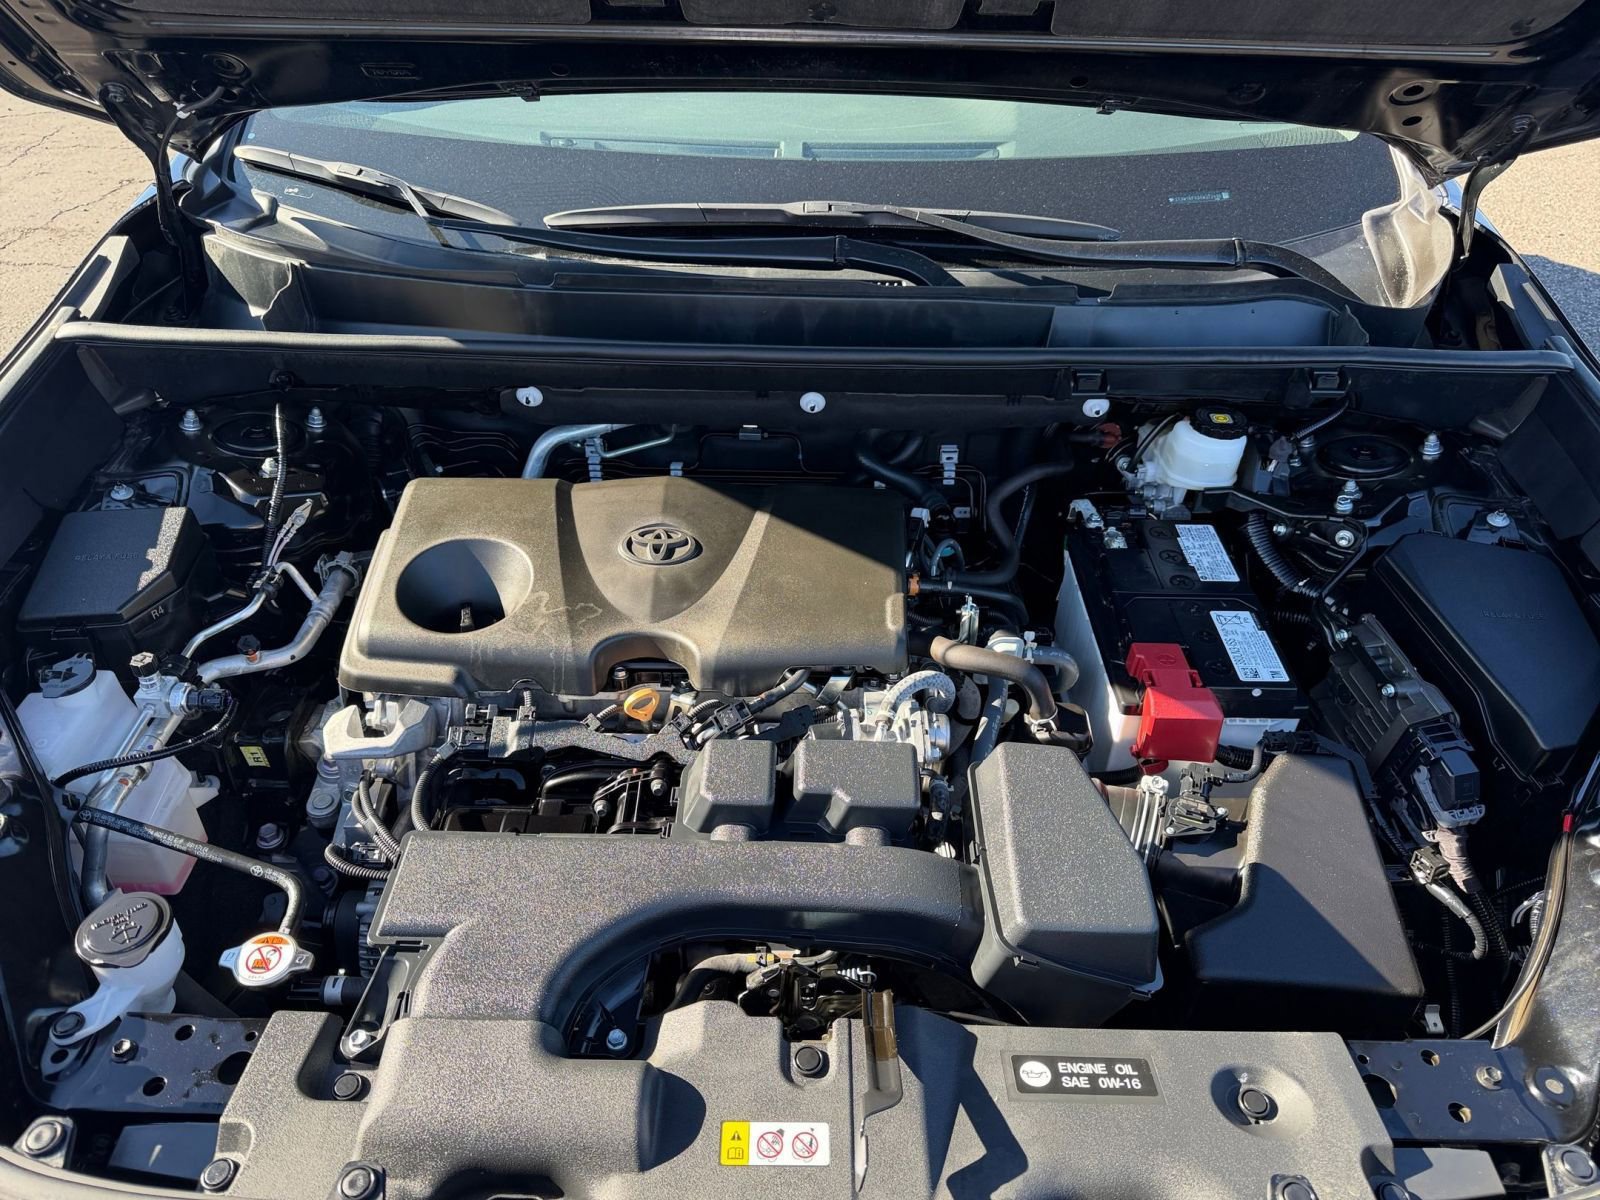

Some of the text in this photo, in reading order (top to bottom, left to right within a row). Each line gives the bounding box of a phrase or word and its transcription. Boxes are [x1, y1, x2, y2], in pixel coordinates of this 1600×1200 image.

[151, 605, 165, 620] R4
[250, 752, 263, 763] R1
[1057, 1062, 1138, 1075] ENGINE OIL
[1062, 1076, 1142, 1090] SAE 0W-16
